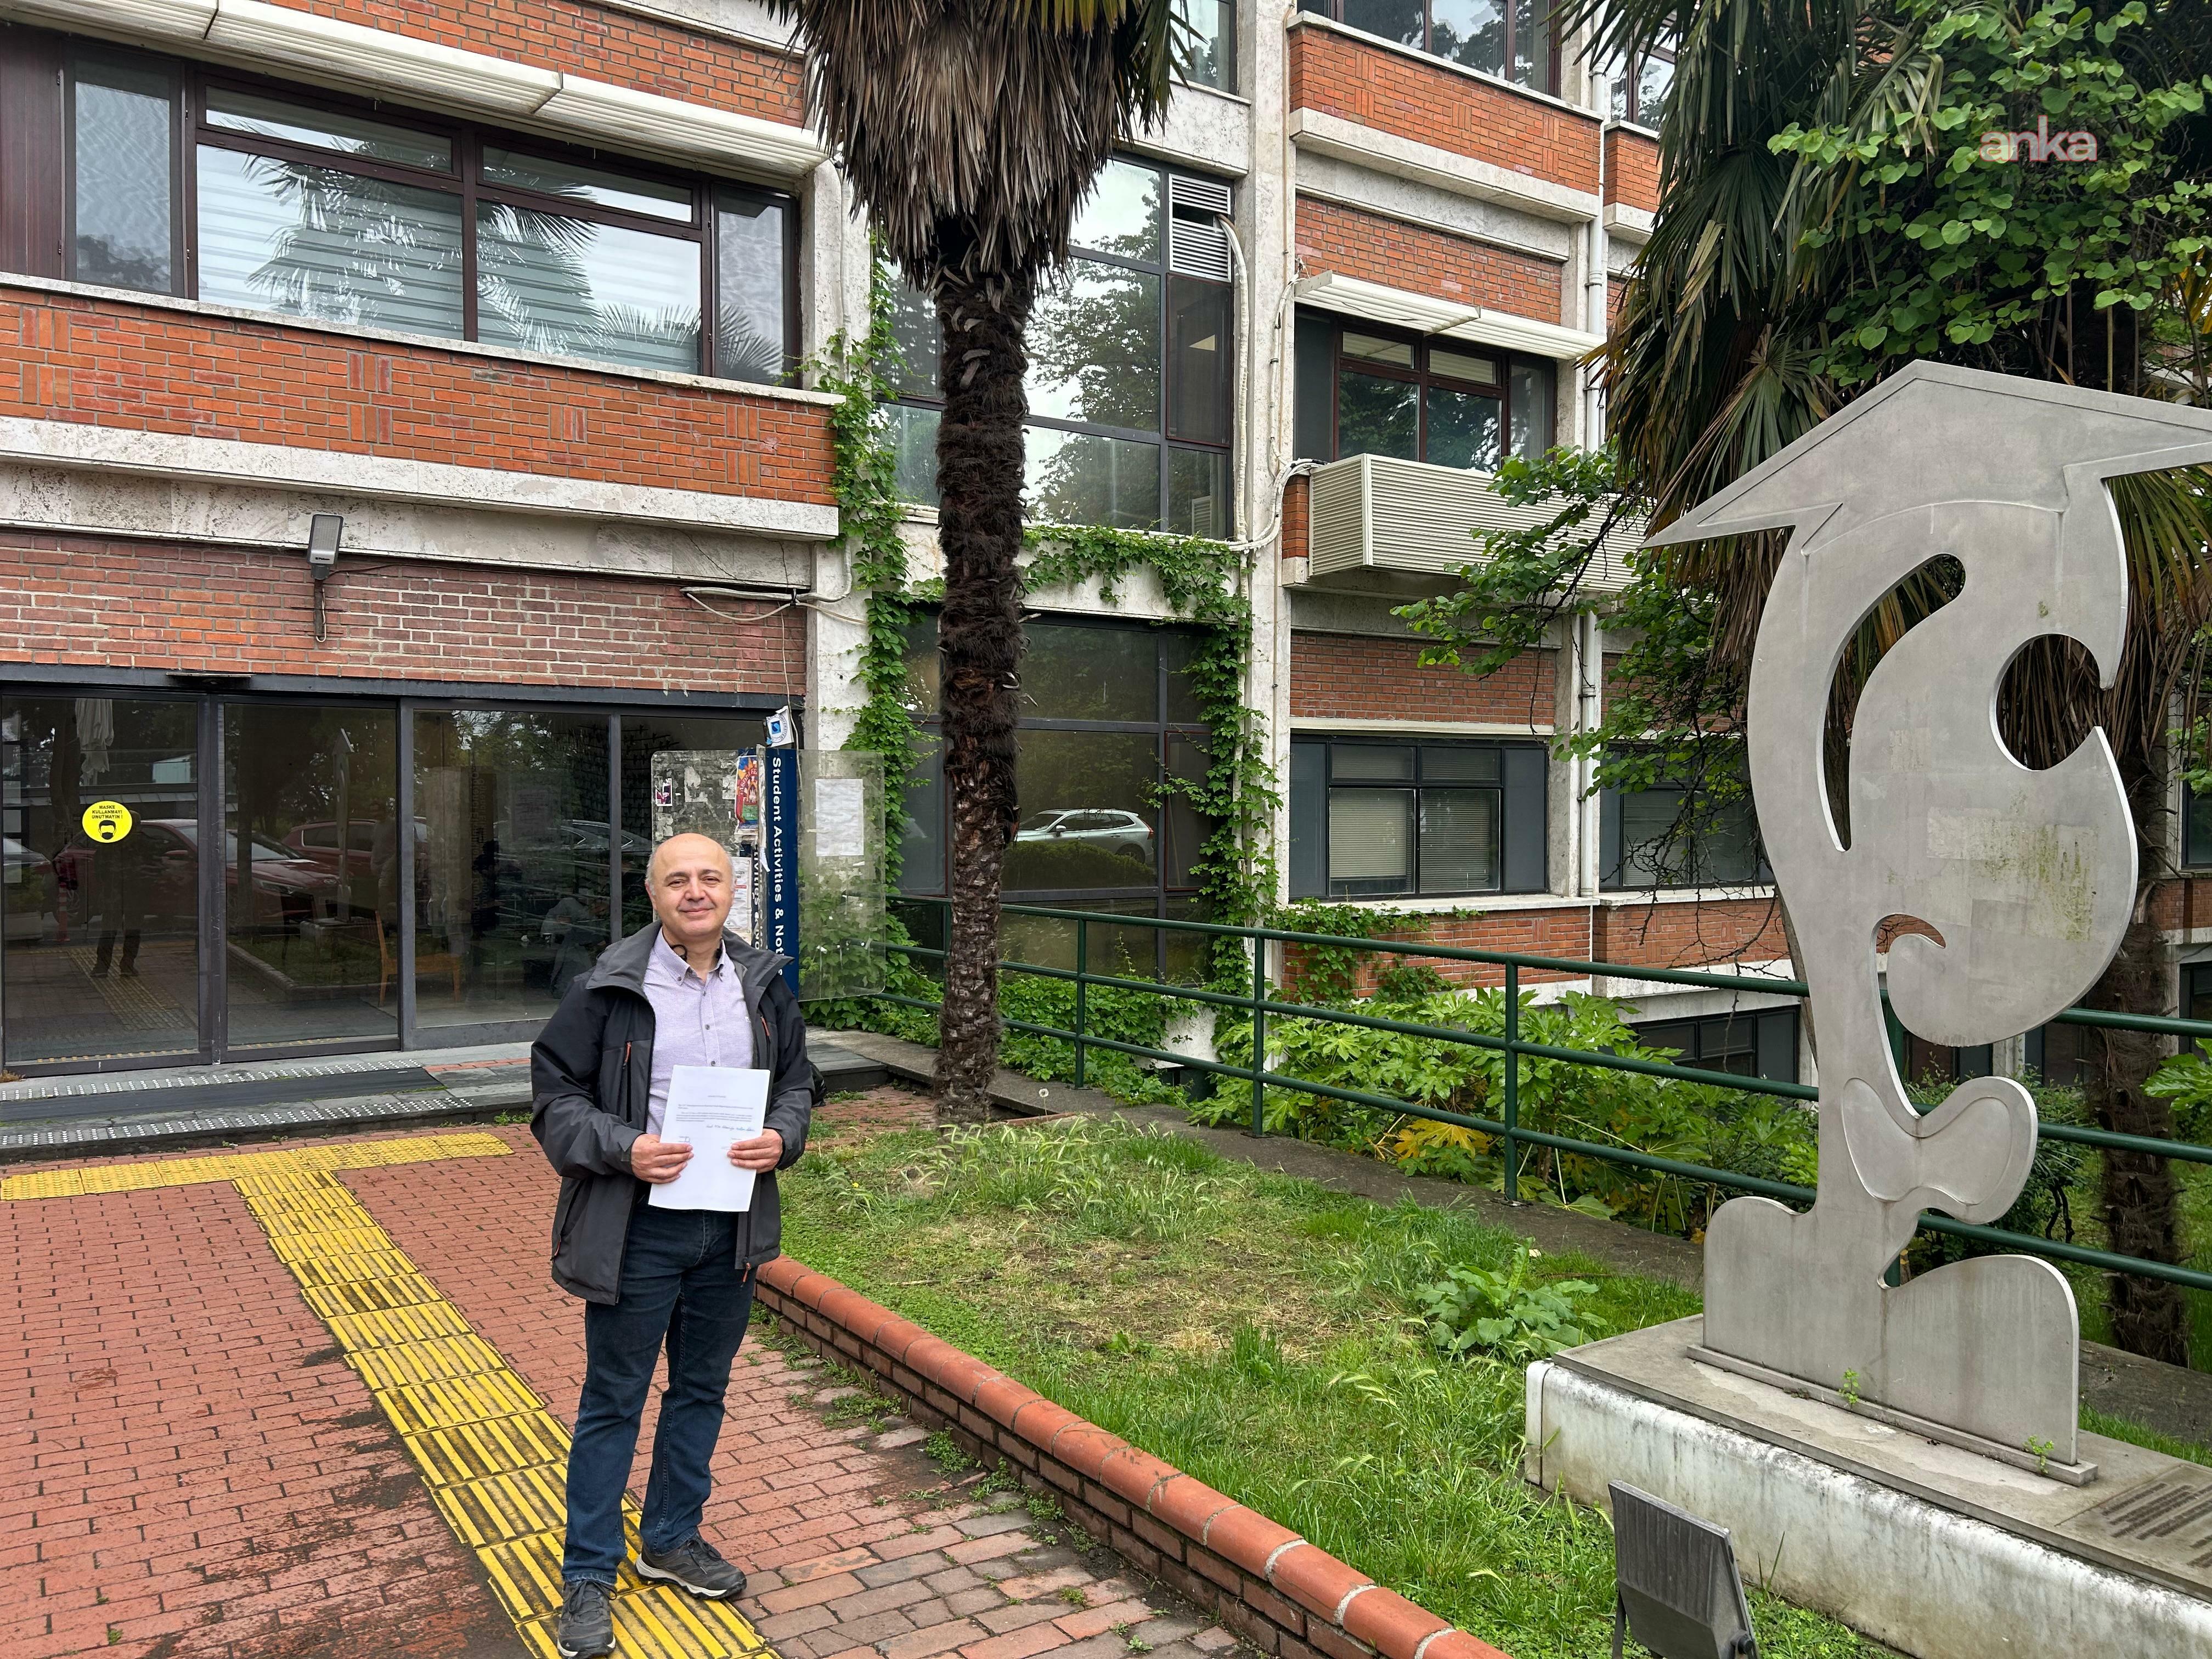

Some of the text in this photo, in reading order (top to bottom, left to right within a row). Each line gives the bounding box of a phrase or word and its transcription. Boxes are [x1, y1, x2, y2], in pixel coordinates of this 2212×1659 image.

[772, 757, 782, 822] Student
[774, 825, 783, 902] Activities
[775, 908, 784, 919] &
